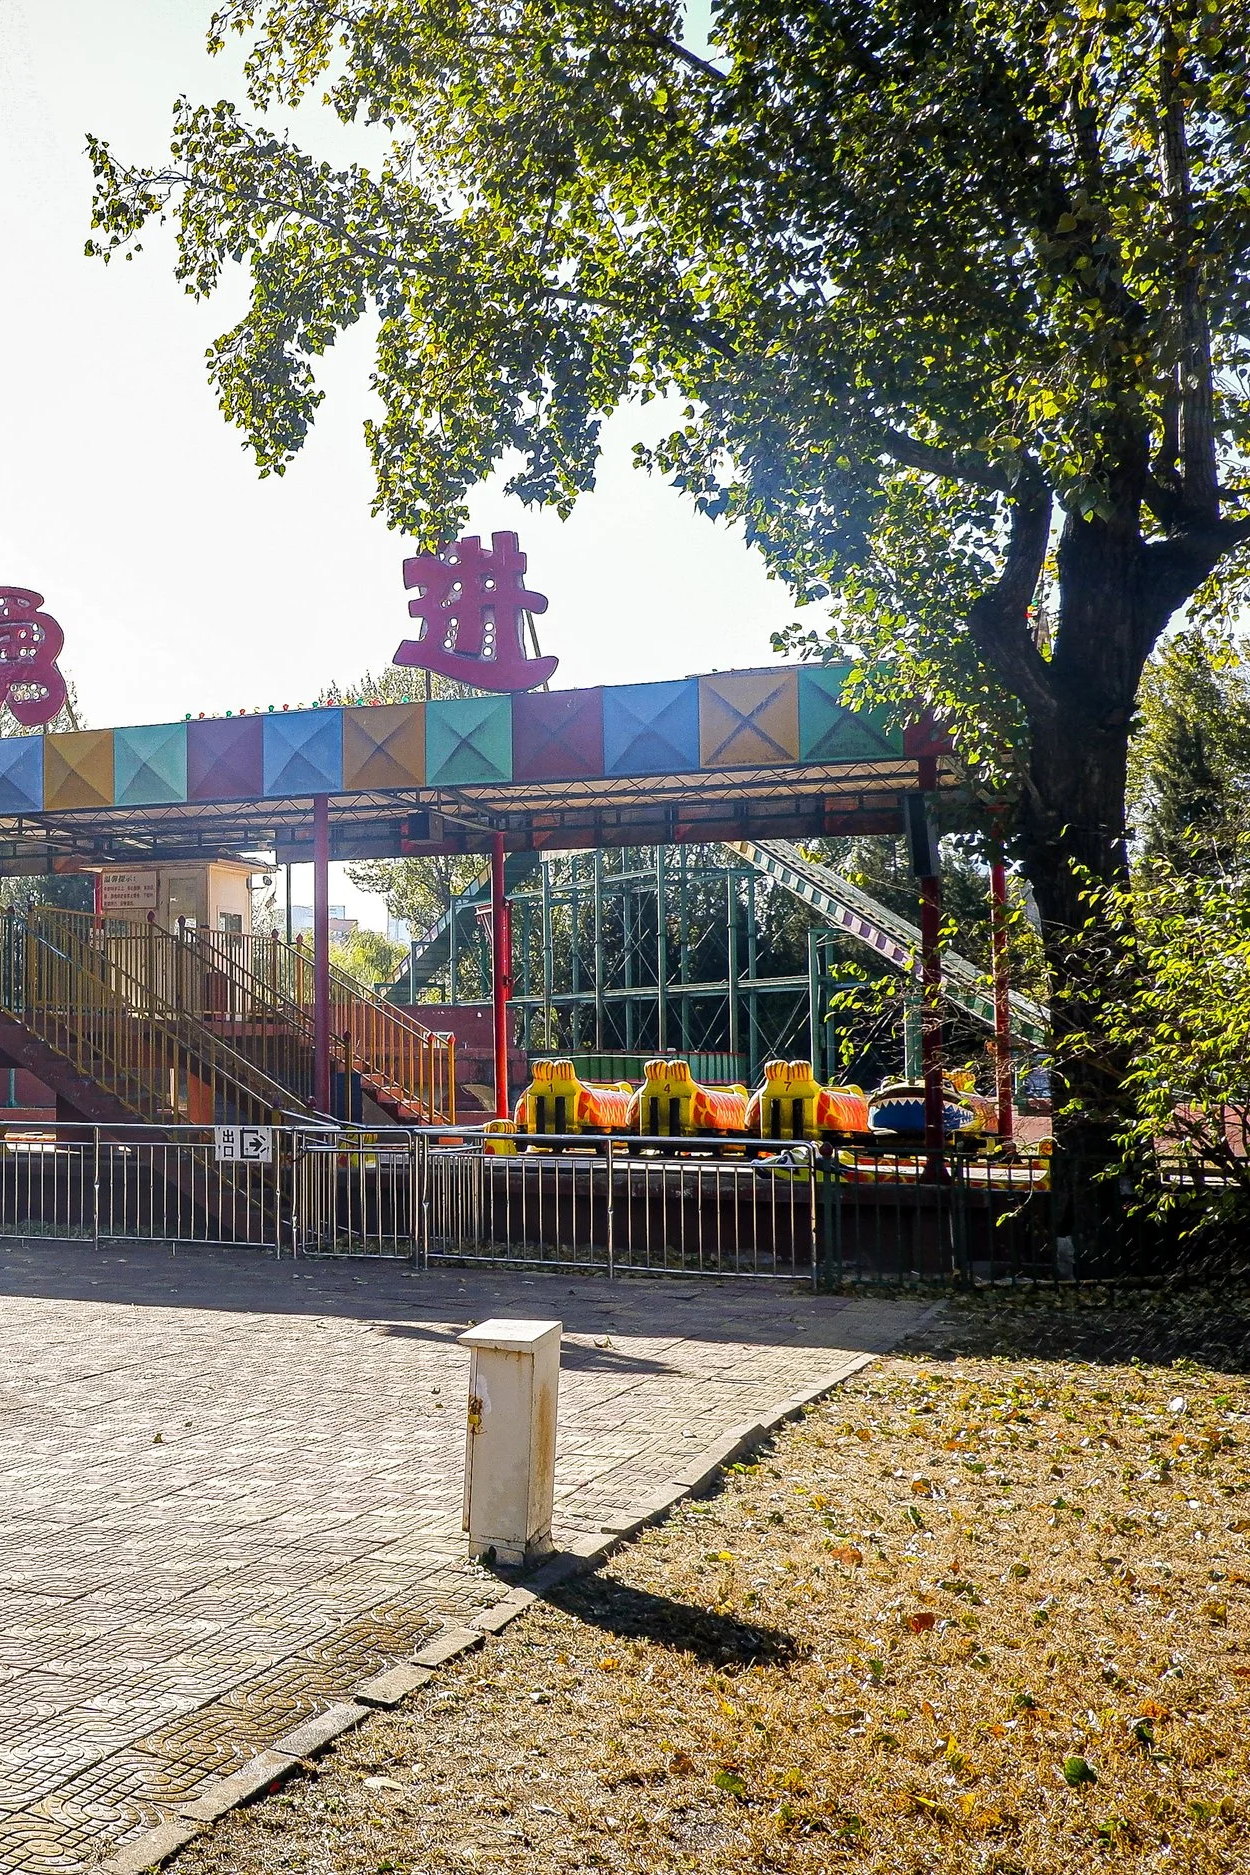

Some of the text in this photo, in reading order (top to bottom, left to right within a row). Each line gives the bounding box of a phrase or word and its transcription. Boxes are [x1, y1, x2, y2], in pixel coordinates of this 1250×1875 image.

[548, 1084, 555, 1093] 1
[662, 1083, 671, 1094] 4
[783, 1082, 792, 1092] 7
[222, 1129, 235, 1158] 出口
